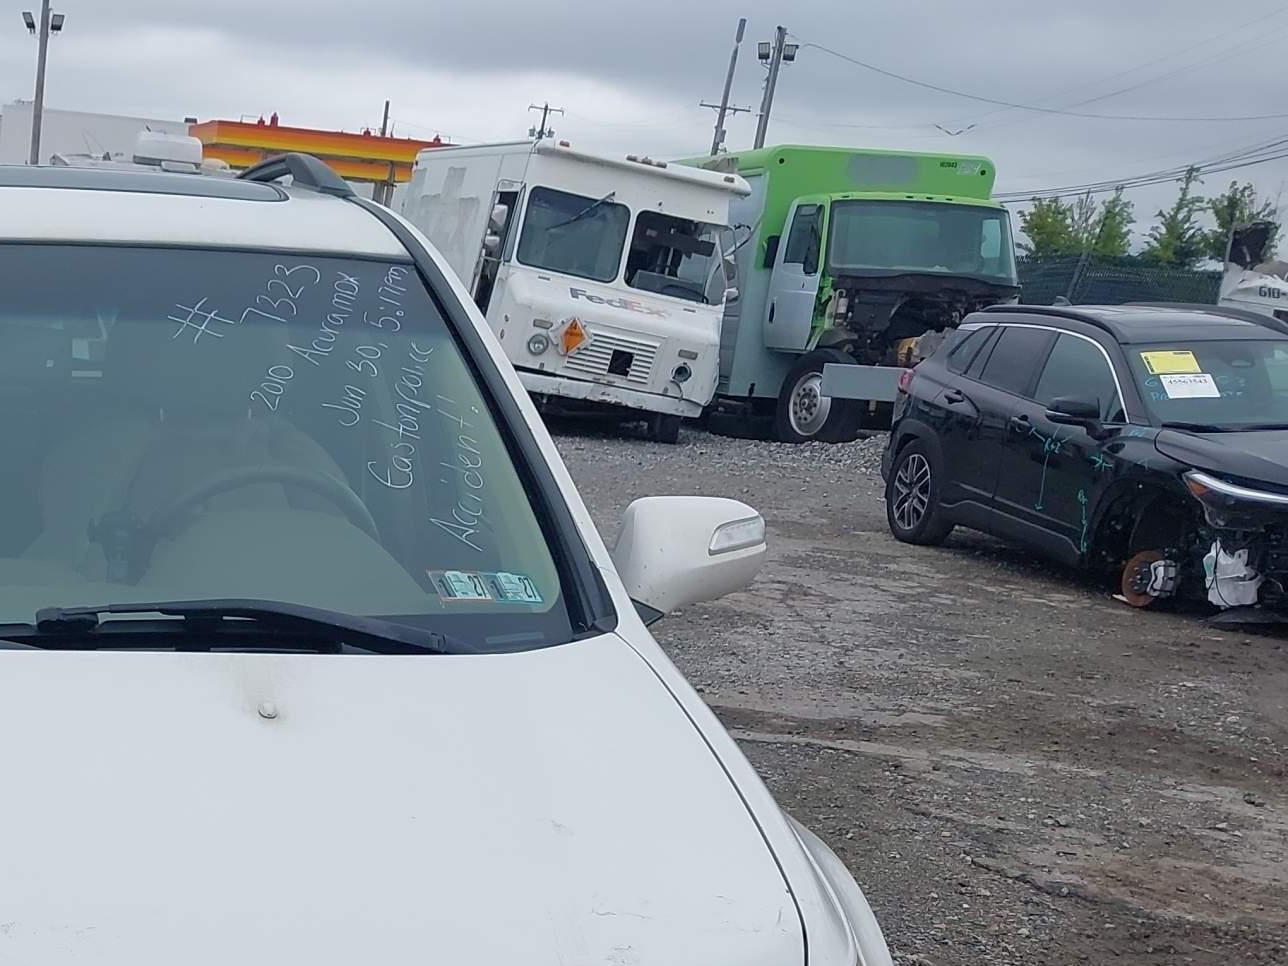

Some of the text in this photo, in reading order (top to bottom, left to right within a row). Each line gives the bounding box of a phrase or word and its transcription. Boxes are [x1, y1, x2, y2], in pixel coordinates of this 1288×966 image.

[167, 264, 321, 344] # 7323
[250, 365, 294, 411] 2010
[321, 384, 367, 427] Jun
